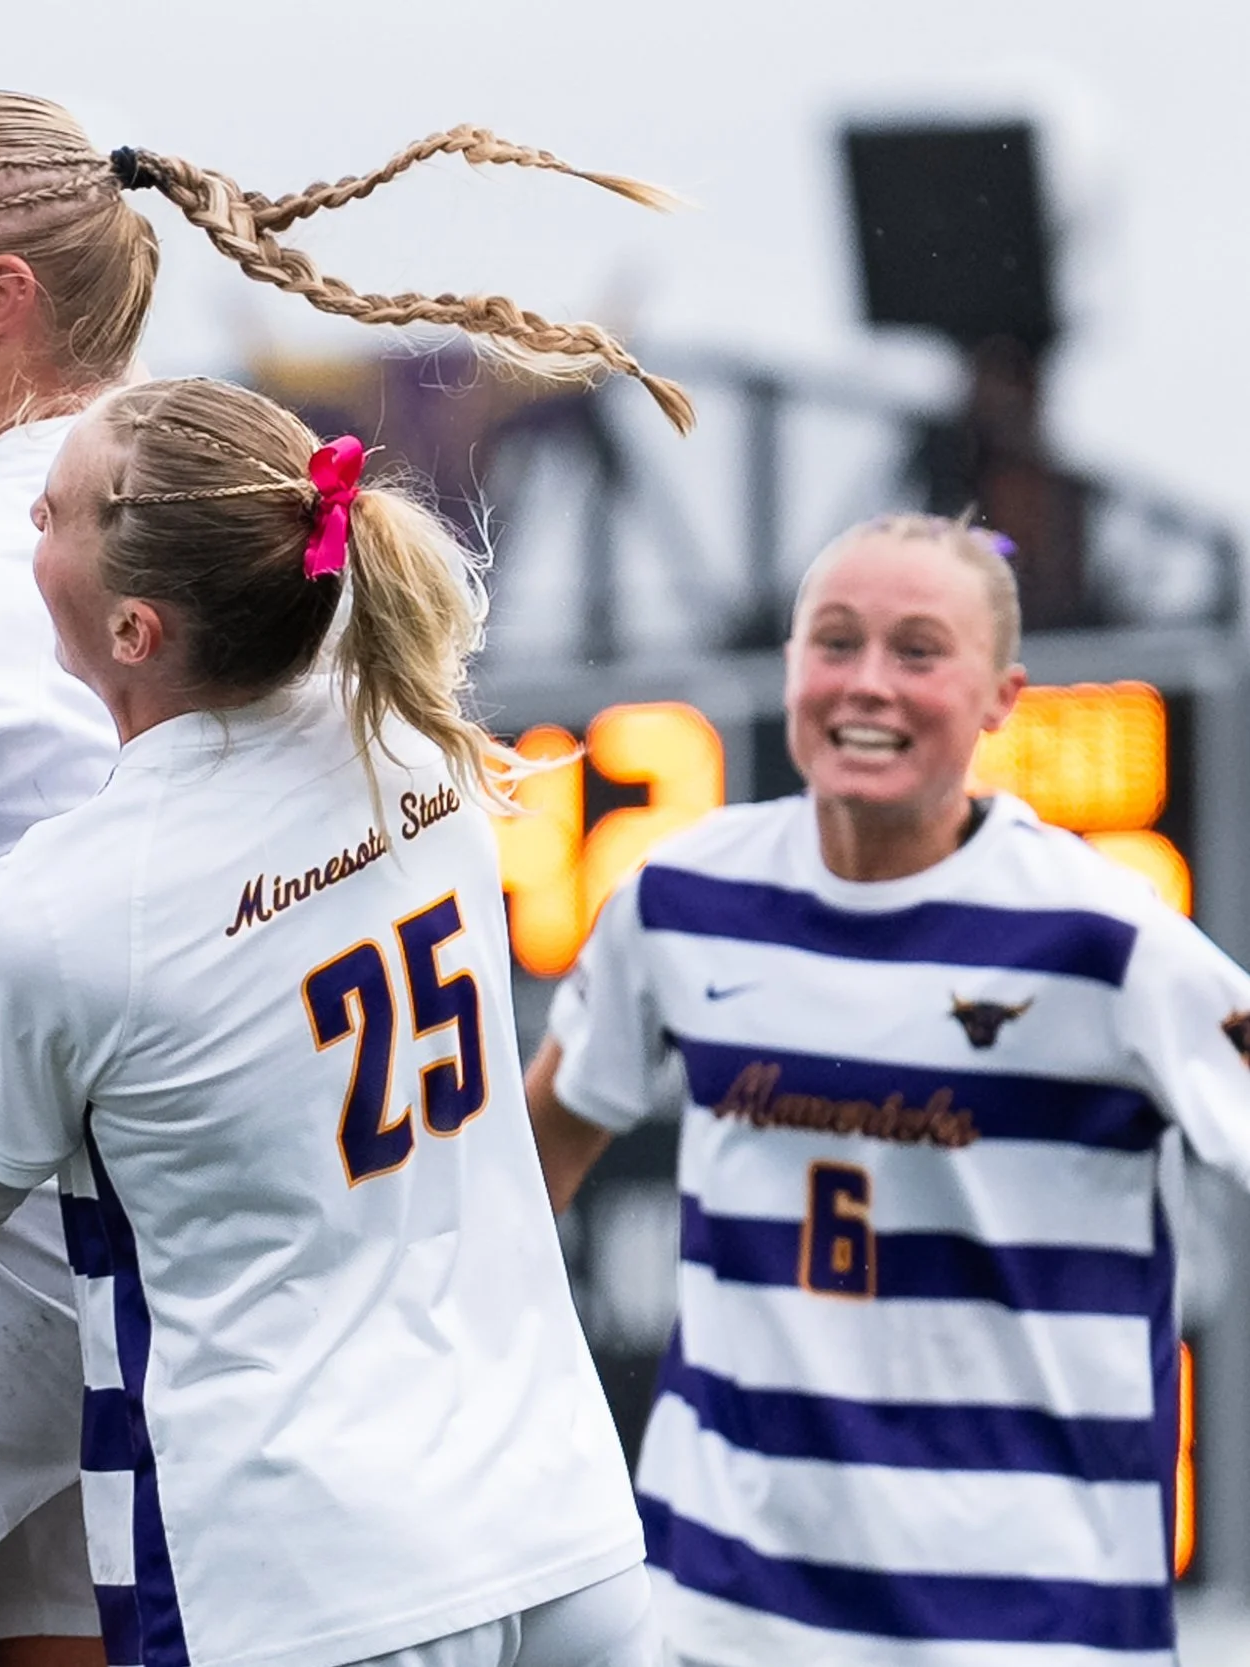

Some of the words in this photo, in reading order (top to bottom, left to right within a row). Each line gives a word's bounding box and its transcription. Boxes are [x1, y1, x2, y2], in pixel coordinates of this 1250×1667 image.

[225, 826, 388, 937] Minnesota
[400, 782, 460, 841] State
[301, 887, 489, 1190] 25
[798, 1157, 877, 1303] 6
